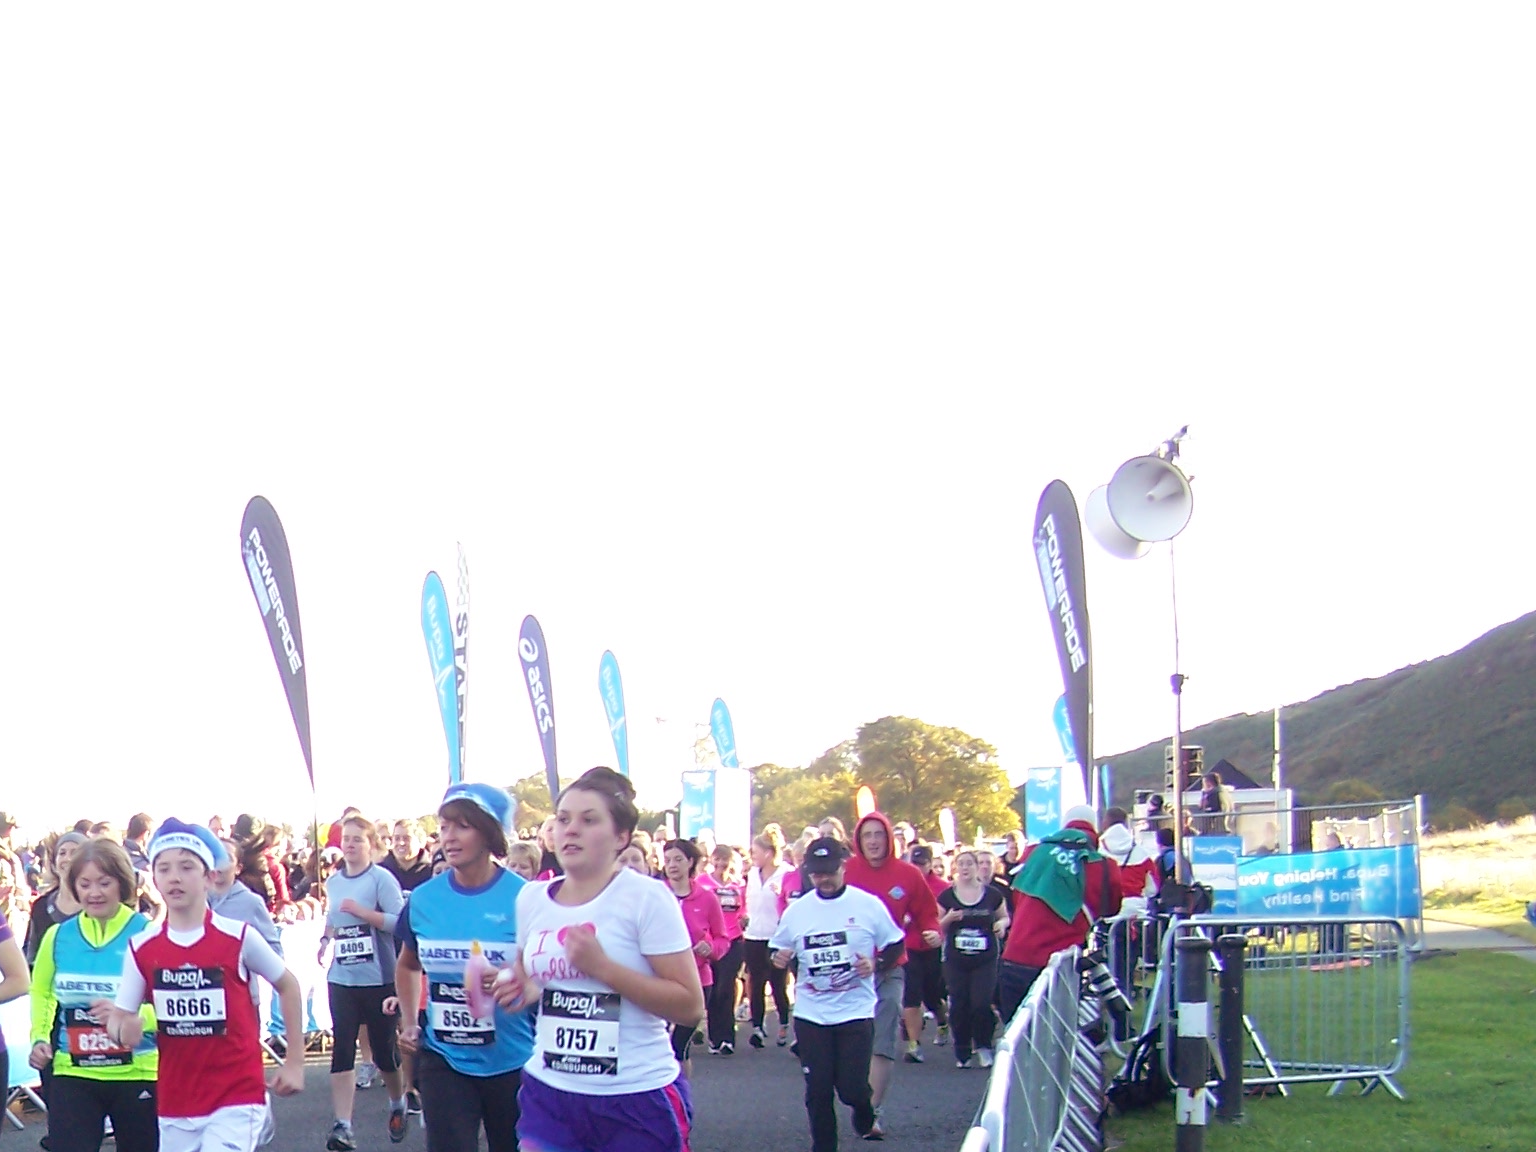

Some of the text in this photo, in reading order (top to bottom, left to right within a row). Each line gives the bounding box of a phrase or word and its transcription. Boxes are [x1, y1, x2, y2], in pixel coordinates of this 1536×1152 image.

[249, 527, 303, 675] POWERADE
[1042, 513, 1086, 673] POWERADE
[427, 595, 444, 661] Bupa
[340, 942, 364, 954] 8409
[812, 950, 841, 964] 8459
[162, 968, 197, 986] Bupa
[166, 996, 212, 1017] 8666
[551, 991, 590, 1012] Bupa
[555, 1026, 599, 1051] 8757
